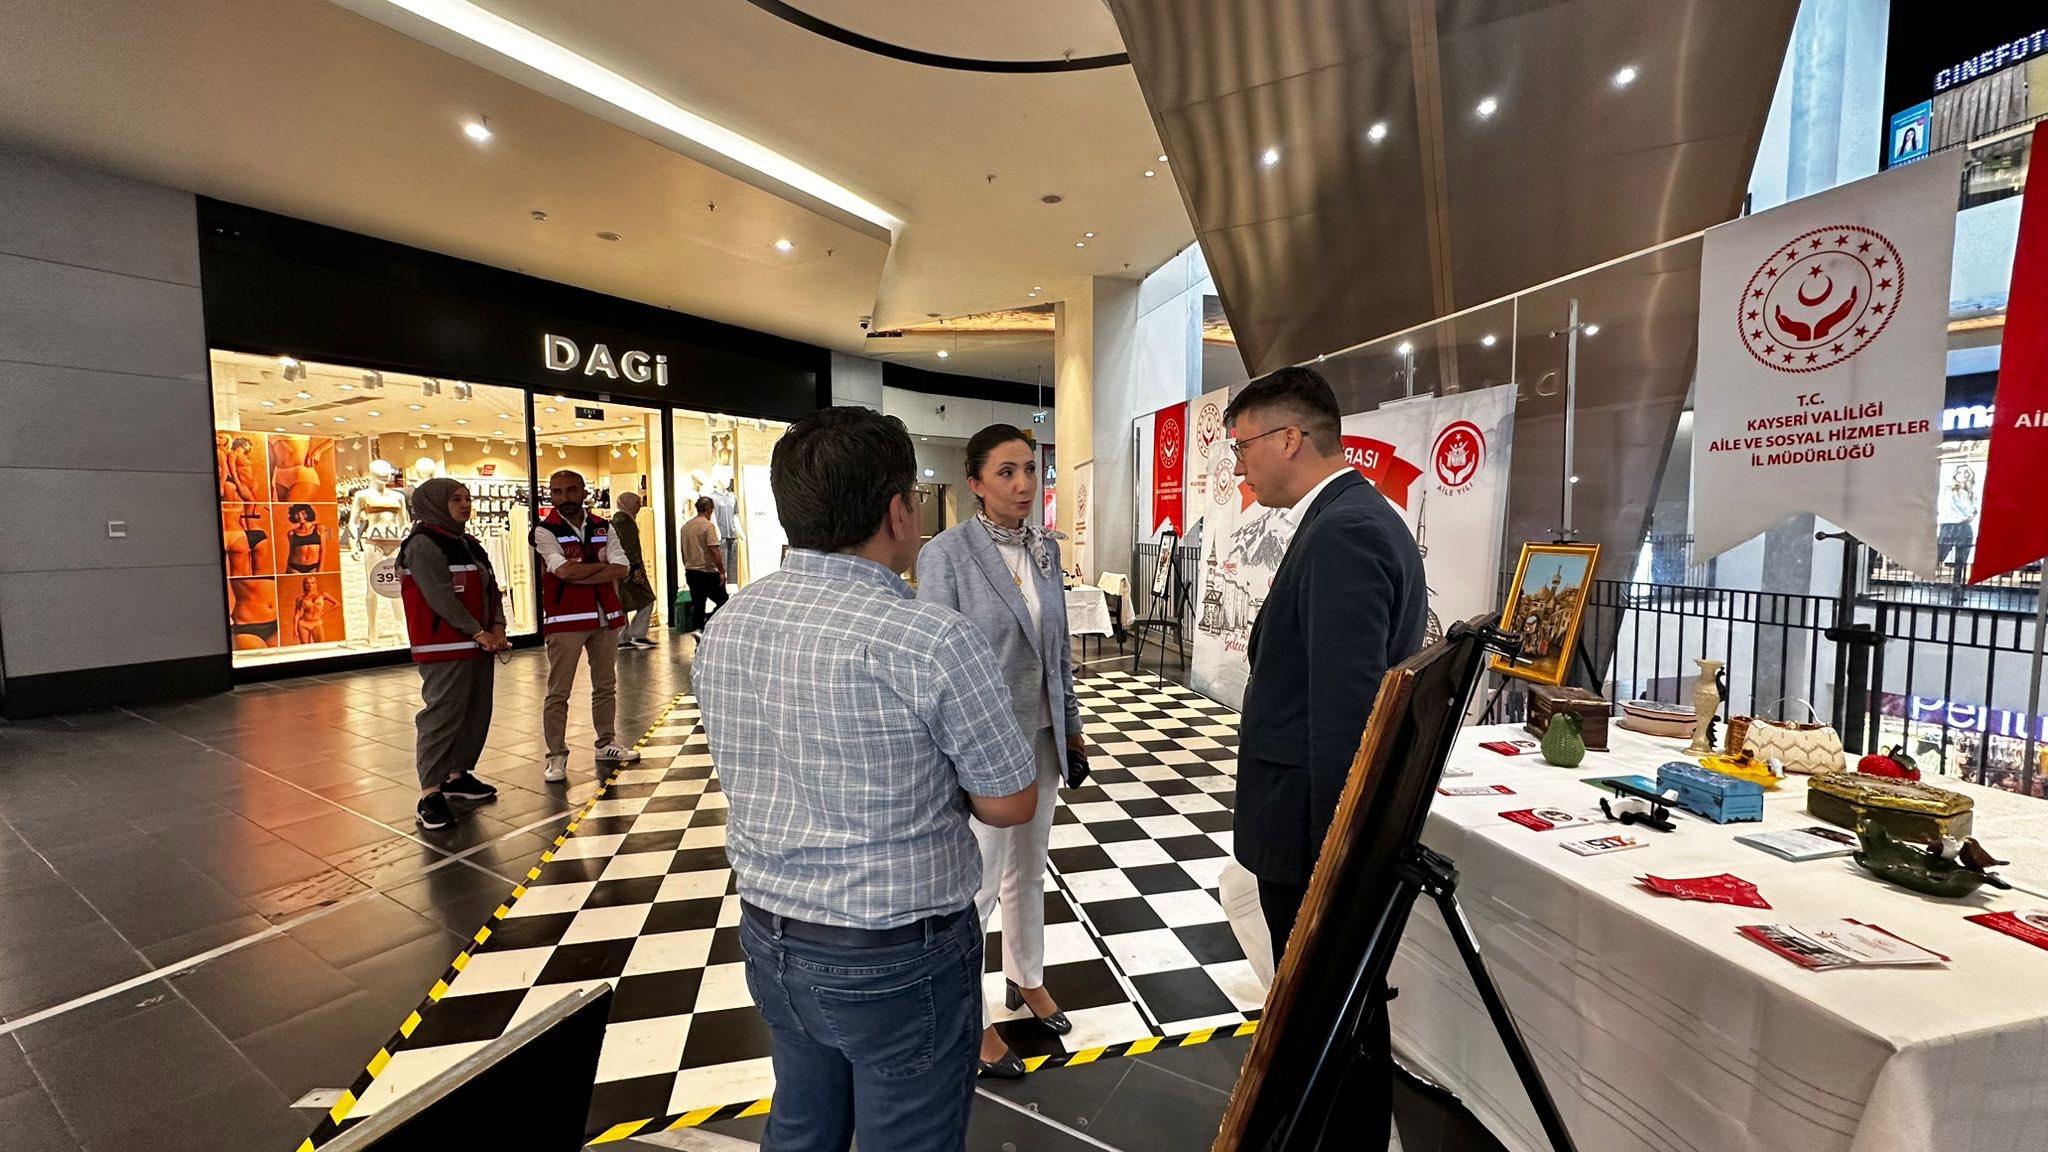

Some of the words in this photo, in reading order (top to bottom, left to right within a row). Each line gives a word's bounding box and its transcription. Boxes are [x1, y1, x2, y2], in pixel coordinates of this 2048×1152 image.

[1935, 29, 2048, 90] CINEFOT
[1797, 393, 1825, 407] T.C.
[1747, 411, 1808, 431] KAYSERİ
[1811, 401, 1883, 424] VALİLİĞİ
[1709, 438, 1741, 452] AİLE
[1744, 437, 1762, 449] VE
[1766, 431, 1825, 447] SOSYAL
[1829, 419, 1930, 442] HİZMETLER
[1343, 447, 1379, 469] RASI
[1751, 452, 1764, 467] İL
[1768, 443, 1875, 465] MÜDÜRLÜĞÜ
